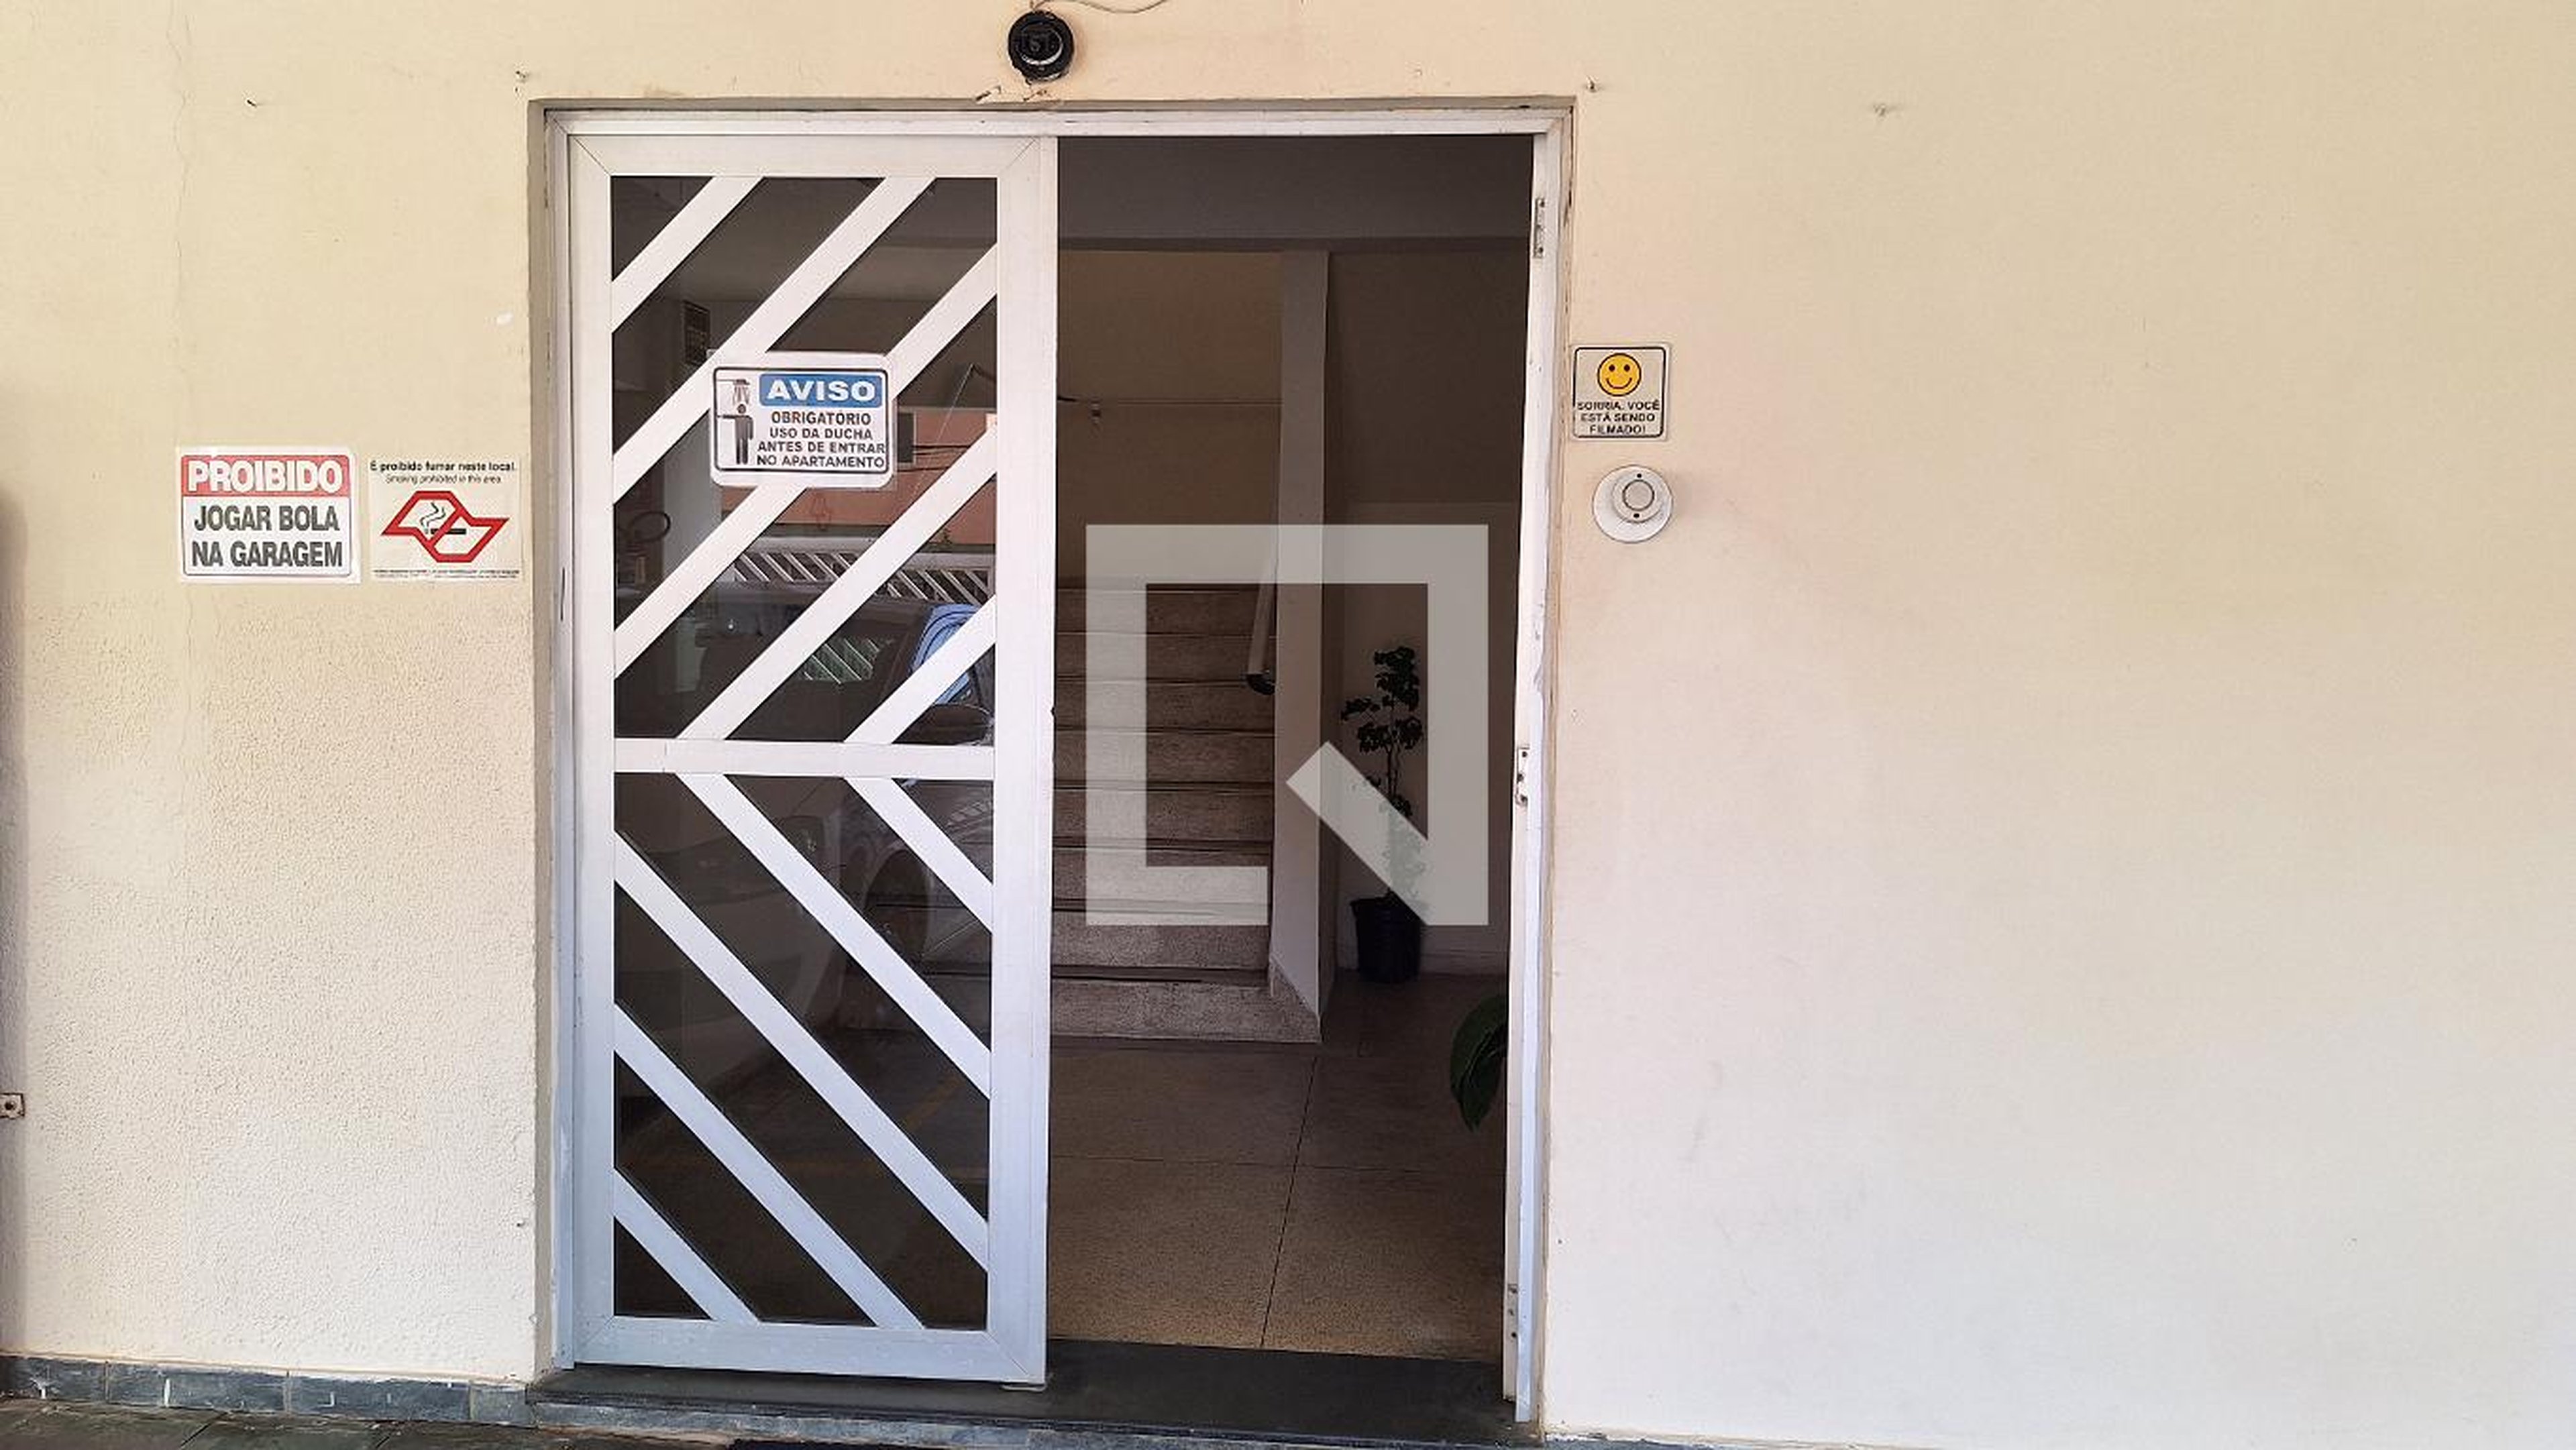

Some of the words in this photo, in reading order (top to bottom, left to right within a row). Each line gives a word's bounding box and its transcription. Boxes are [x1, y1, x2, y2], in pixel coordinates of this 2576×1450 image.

[767, 379, 875, 402] AVISO
[1627, 399, 1660, 410] VOCÊ
[1580, 412, 1611, 422] ESTÁ
[1614, 412, 1655, 422] SENDO
[769, 427, 798, 439] USO
[802, 428, 820, 439] DA
[824, 428, 873, 440] DUCHA
[1589, 425, 1646, 435] FILMADO!
[757, 441, 803, 453] ANTES
[808, 441, 824, 453] DE
[830, 442, 885, 454] ENTRAR
[380, 461, 423, 473] proibido
[425, 461, 455, 471] fumar
[458, 462, 486, 471] neste
[757, 455, 777, 466] NO
[781, 455, 885, 468] APARTAMENTO
[188, 459, 343, 494] PROIBIDO
[194, 504, 272, 531] JOGAR
[279, 504, 340, 531] BOLA
[192, 541, 223, 567] NA
[229, 541, 343, 567] GARAGEM
